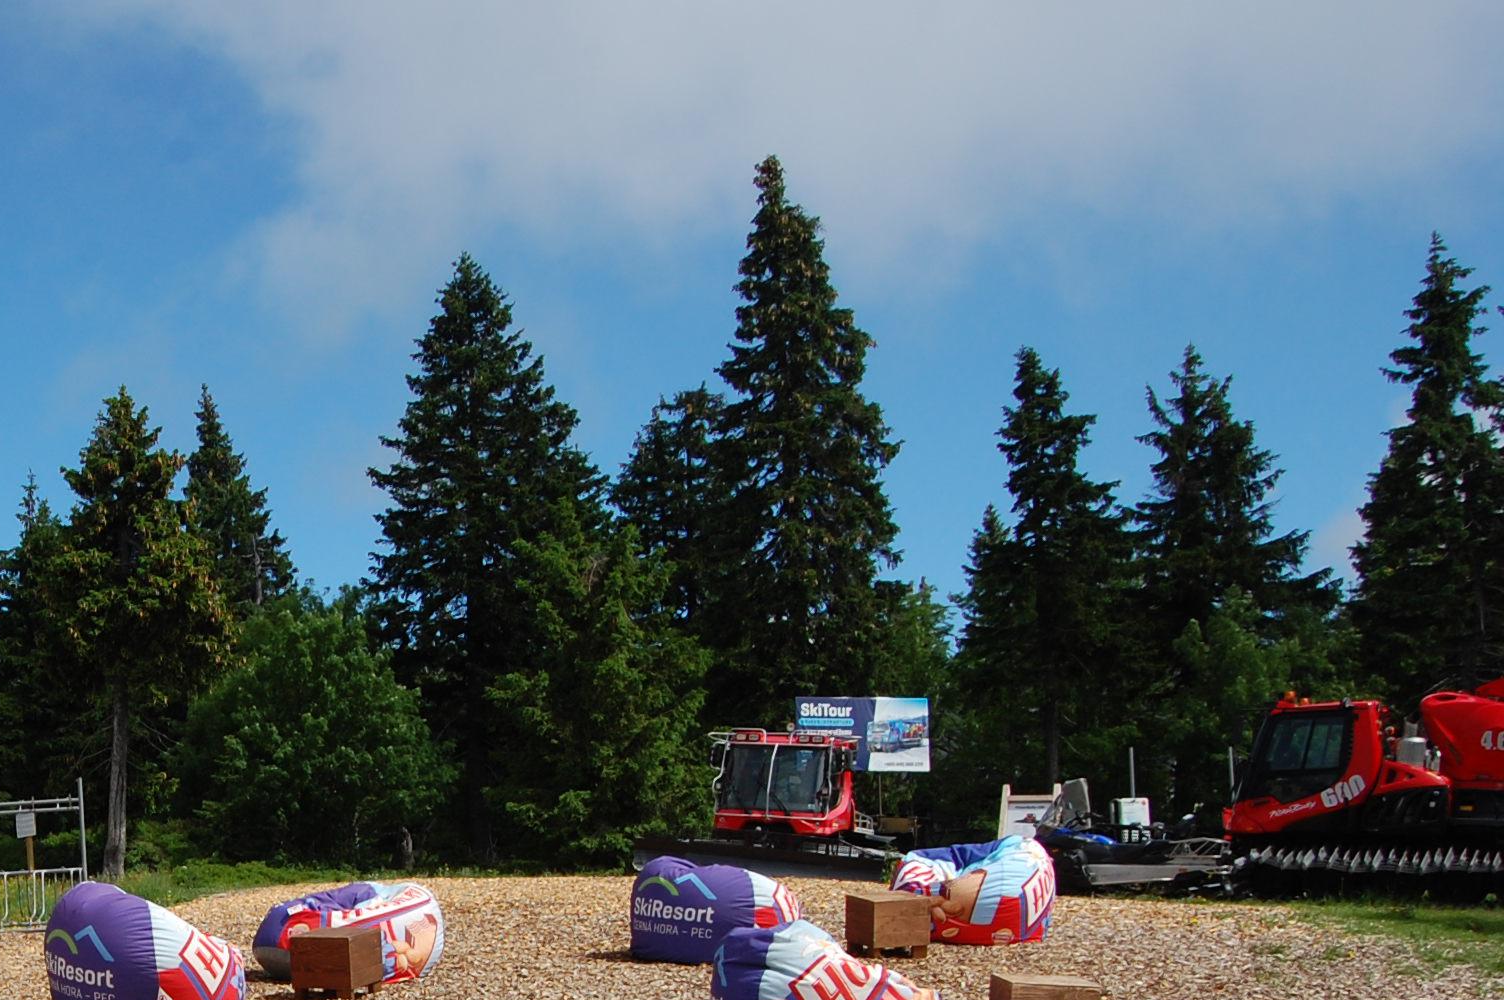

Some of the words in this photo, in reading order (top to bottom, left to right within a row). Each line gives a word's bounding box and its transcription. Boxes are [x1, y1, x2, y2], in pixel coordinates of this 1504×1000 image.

[800, 702, 853, 718] SkiTour
[634, 897, 715, 924] SkiResort
[653, 922, 679, 936] HORA
[691, 927, 713, 940] PEC
[46, 950, 114, 989] kiResort
